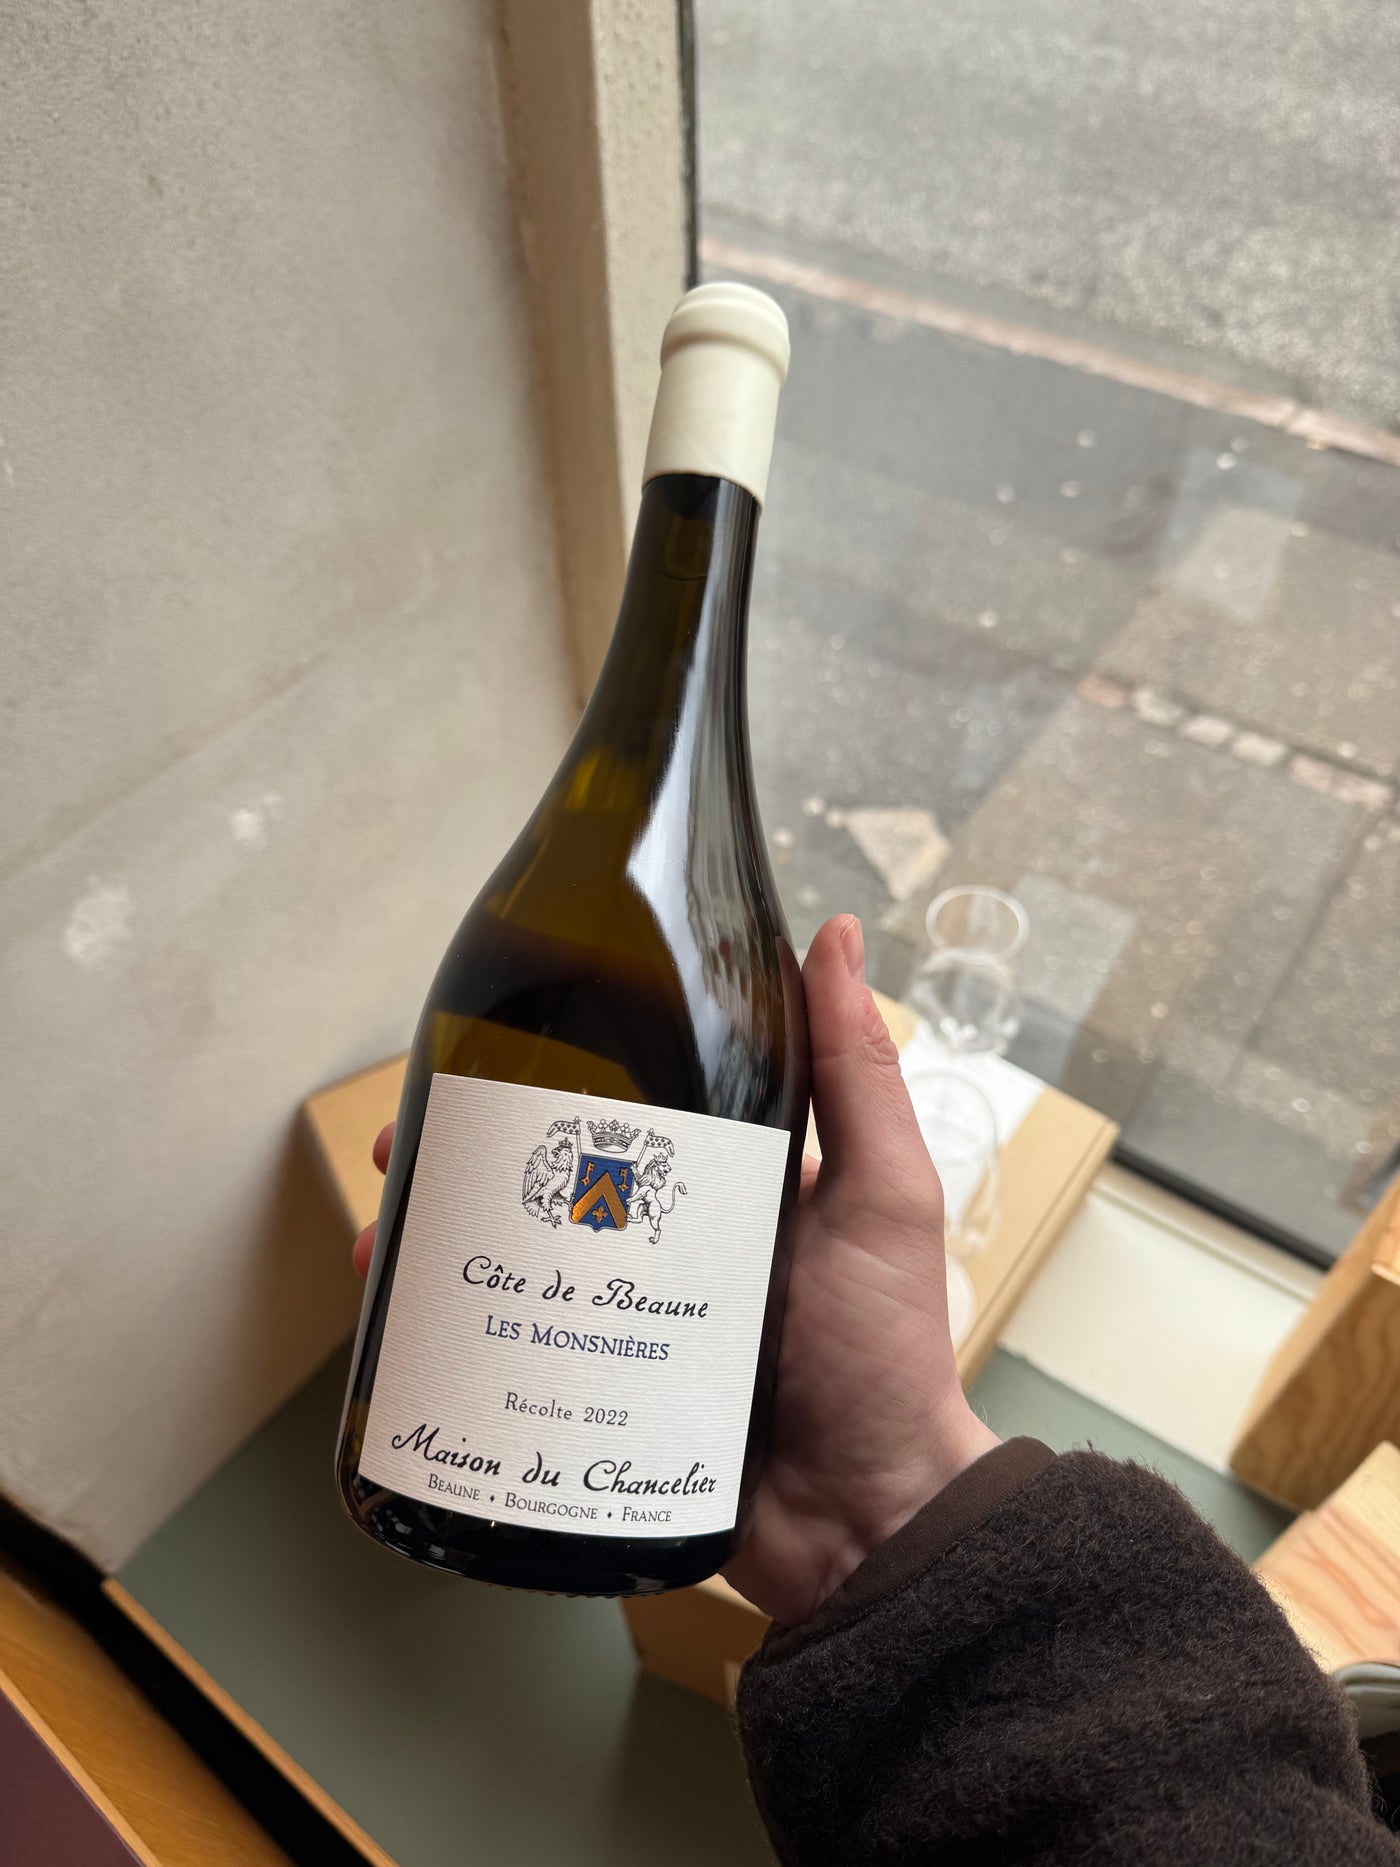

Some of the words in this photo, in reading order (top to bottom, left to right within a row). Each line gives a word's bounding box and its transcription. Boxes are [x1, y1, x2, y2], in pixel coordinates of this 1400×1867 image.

[462, 1255, 527, 1294] Côte
[541, 1269, 576, 1302] de
[591, 1277, 709, 1319] Beaune
[484, 1314, 523, 1341] LES
[529, 1322, 671, 1361] MONSNIÈRES
[504, 1391, 573, 1421] Récolte
[583, 1406, 629, 1427] 2022
[391, 1423, 502, 1476] Maison
[521, 1450, 561, 1488] du
[582, 1459, 717, 1496] Chancelier
[427, 1472, 481, 1501] BEAUNE
[504, 1491, 599, 1520] BOURGOGNE
[621, 1506, 672, 1523] FRANCE
